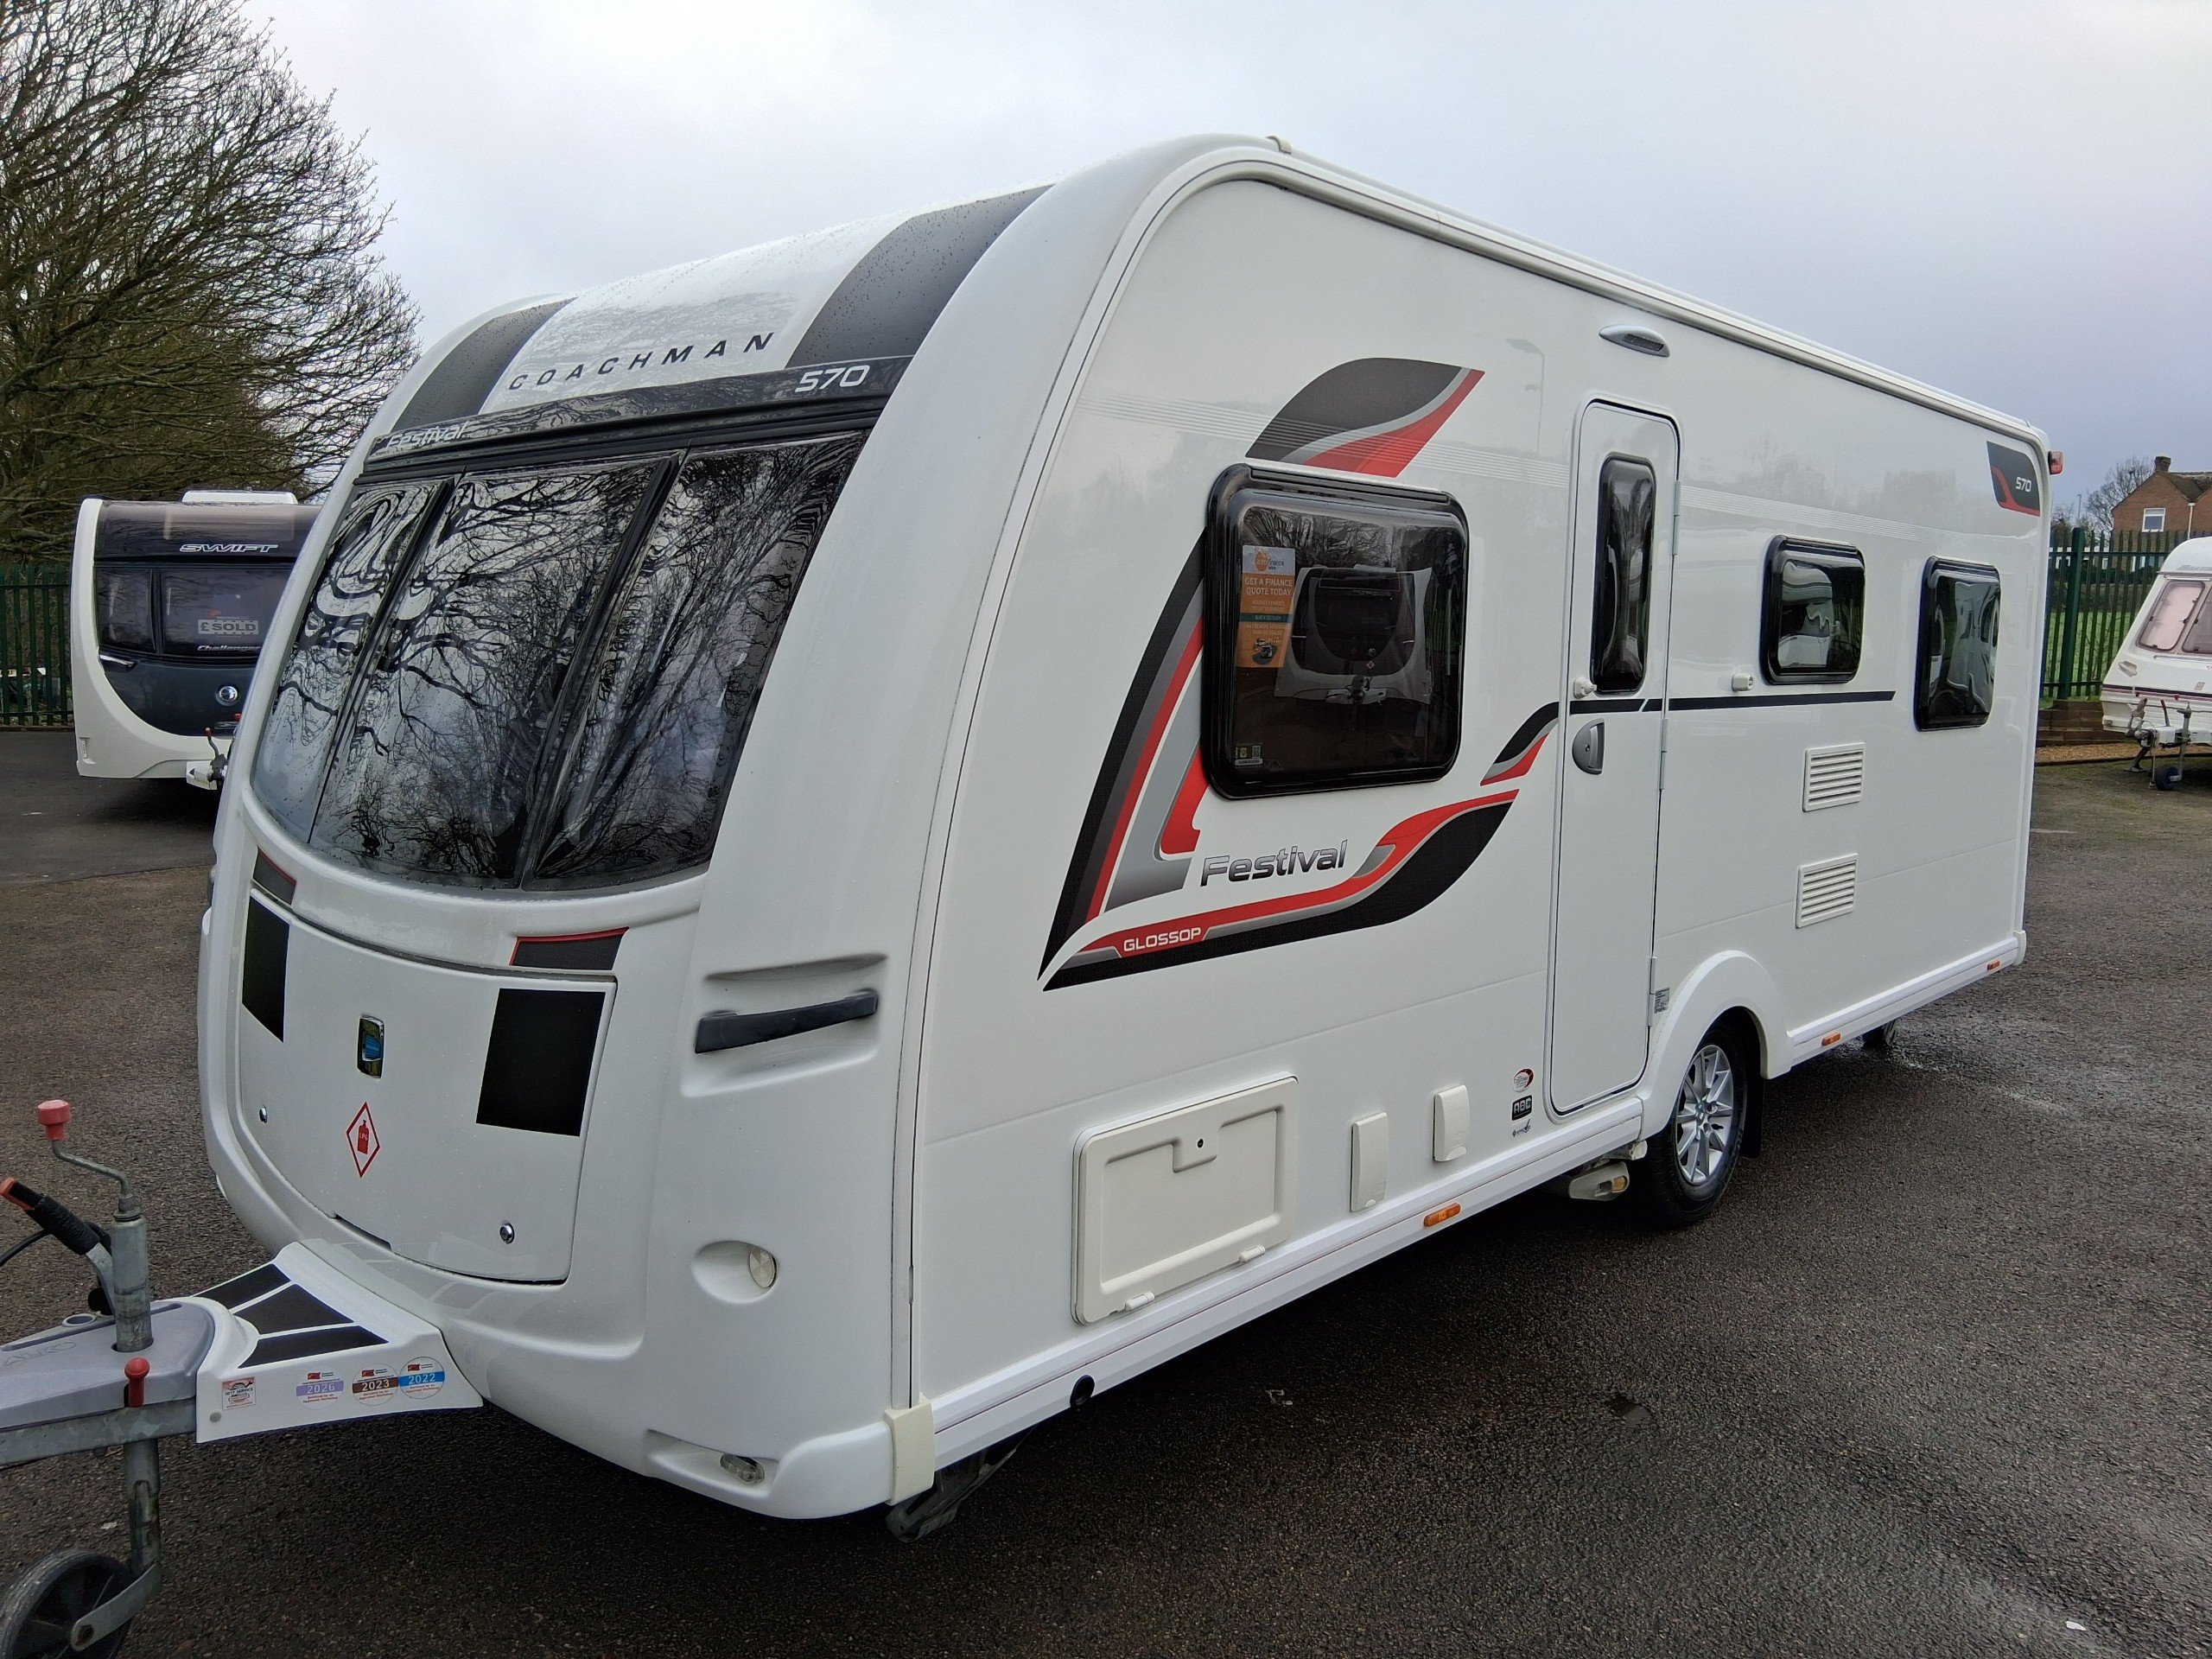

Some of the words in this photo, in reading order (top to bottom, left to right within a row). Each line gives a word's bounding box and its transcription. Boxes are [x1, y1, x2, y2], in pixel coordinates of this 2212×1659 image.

[508, 333, 774, 391] COACHMAN
[794, 365, 870, 393] 570
[385, 420, 469, 450] Festival
[2015, 476, 2031, 493] 570
[180, 543, 278, 553] SWIFT
[1245, 577, 1257, 586] GET
[1265, 578, 1294, 588] FINANCE
[1246, 587, 1269, 595] QUOTE
[1270, 588, 1292, 596] TODAY
[212, 622, 257, 632] SOLD
[1199, 839, 1348, 887] Festival
[1123, 927, 1202, 952] GLOSSOP
[359, 1132, 368, 1141] LPG
[408, 1373, 435, 1384] 2022
[306, 1382, 335, 1394] 2026
[361, 1379, 390, 1391] 2023
